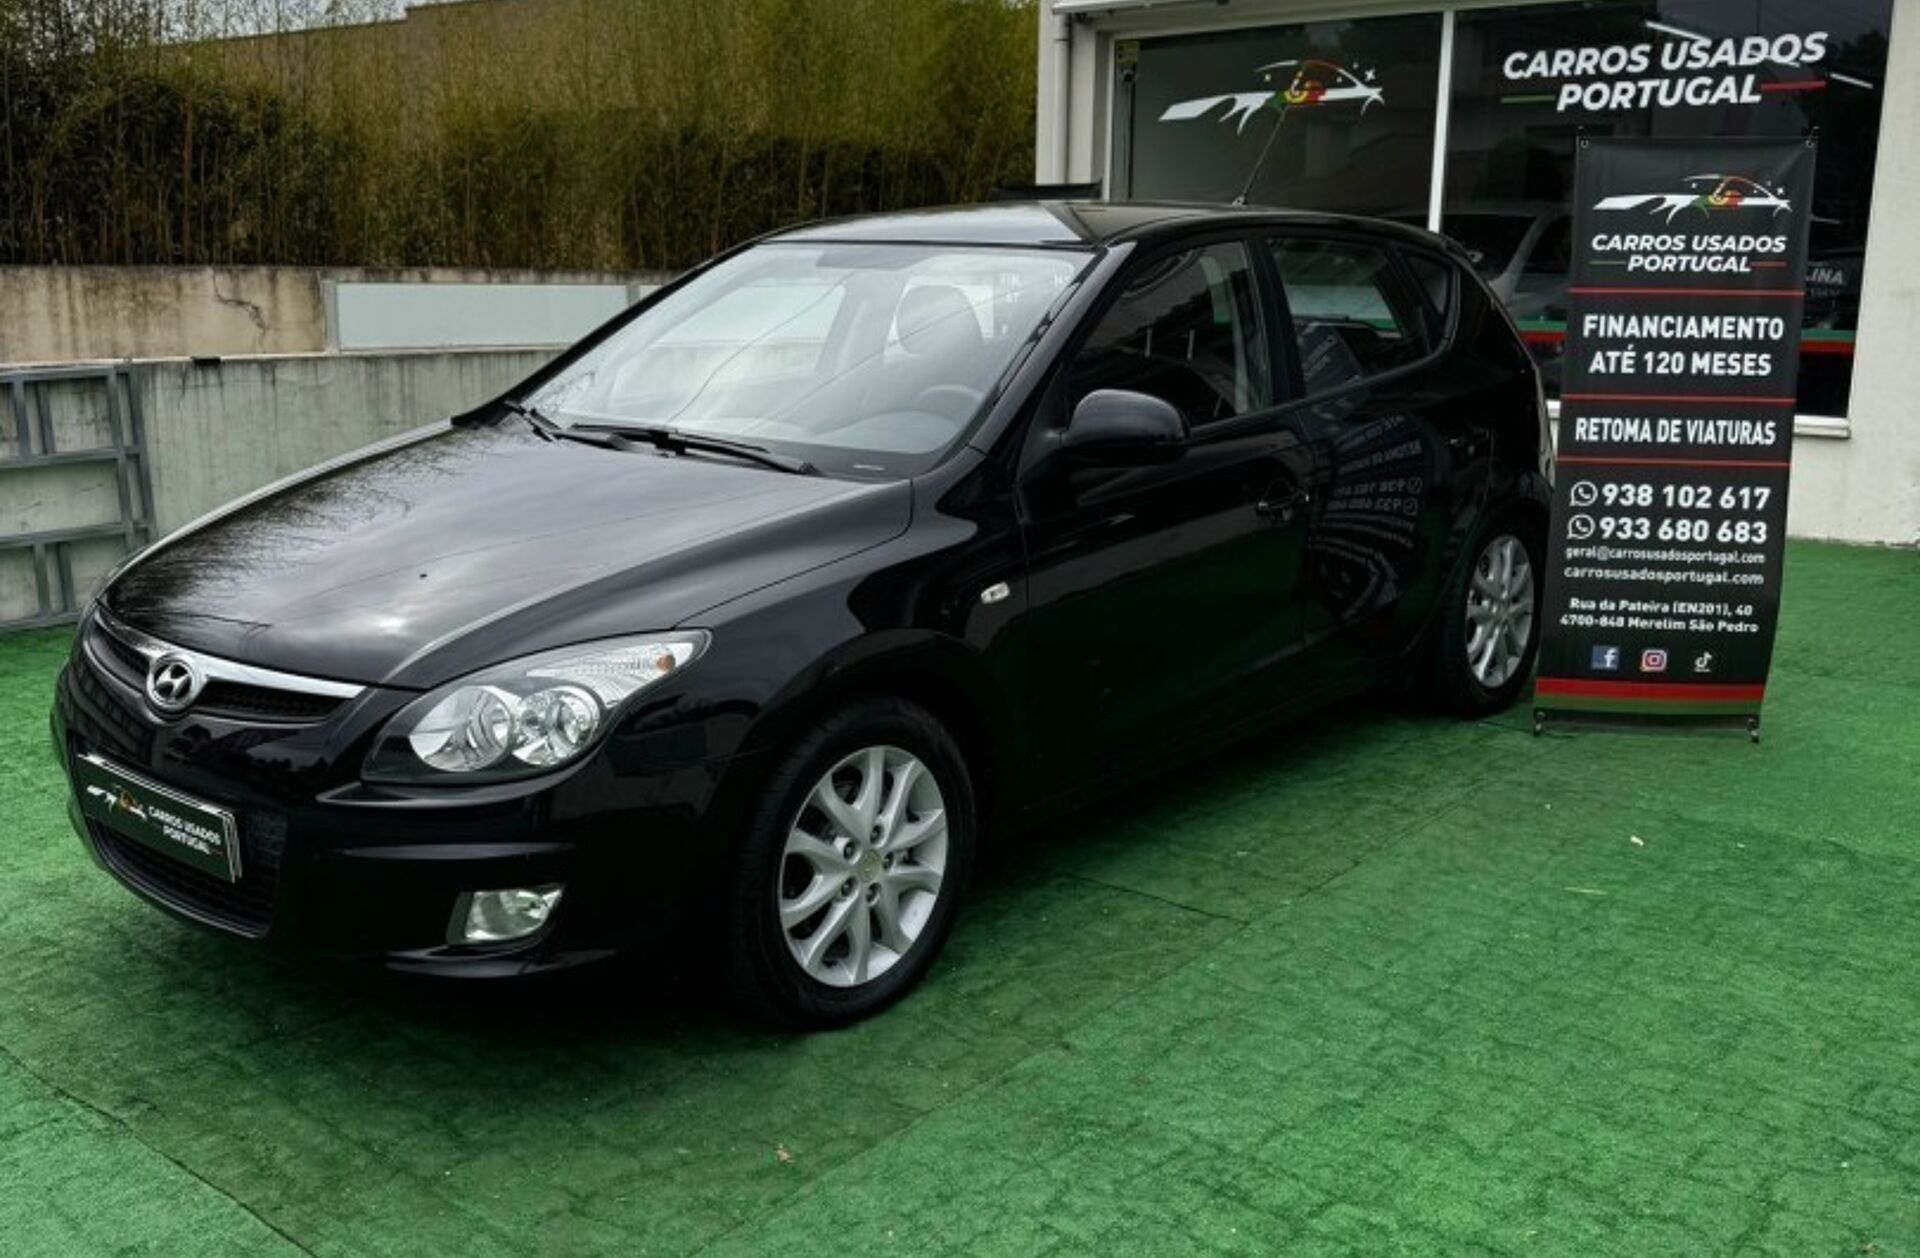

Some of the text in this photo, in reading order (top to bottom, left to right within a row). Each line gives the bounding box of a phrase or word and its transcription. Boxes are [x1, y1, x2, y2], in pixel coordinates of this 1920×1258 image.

[1504, 32, 1828, 79] CARROS USADOS
[1556, 75, 1761, 111] PORTUGAL
[1592, 235, 1786, 252] CARROS USADOS
[1628, 255, 1750, 272] PORTUGAL
[1583, 315, 1783, 340] FINANCIAMENTO
[1589, 344, 1771, 375] ATÉ 120 MESES
[1576, 418, 1775, 445] RETOMA DE VIATURAS
[1603, 484, 1770, 509] 938 102 617
[1600, 517, 1766, 543] 933 680 683
[1564, 567, 1764, 585] carrosusadosportugal.com
[1570, 598, 1596, 609] Rua
[1600, 600, 1615, 610] da
[1619, 600, 1669, 612] Pateira
[1628, 617, 1685, 629] Merelim
[1689, 619, 1714, 631] São
[1718, 621, 1758, 632] Pedro
